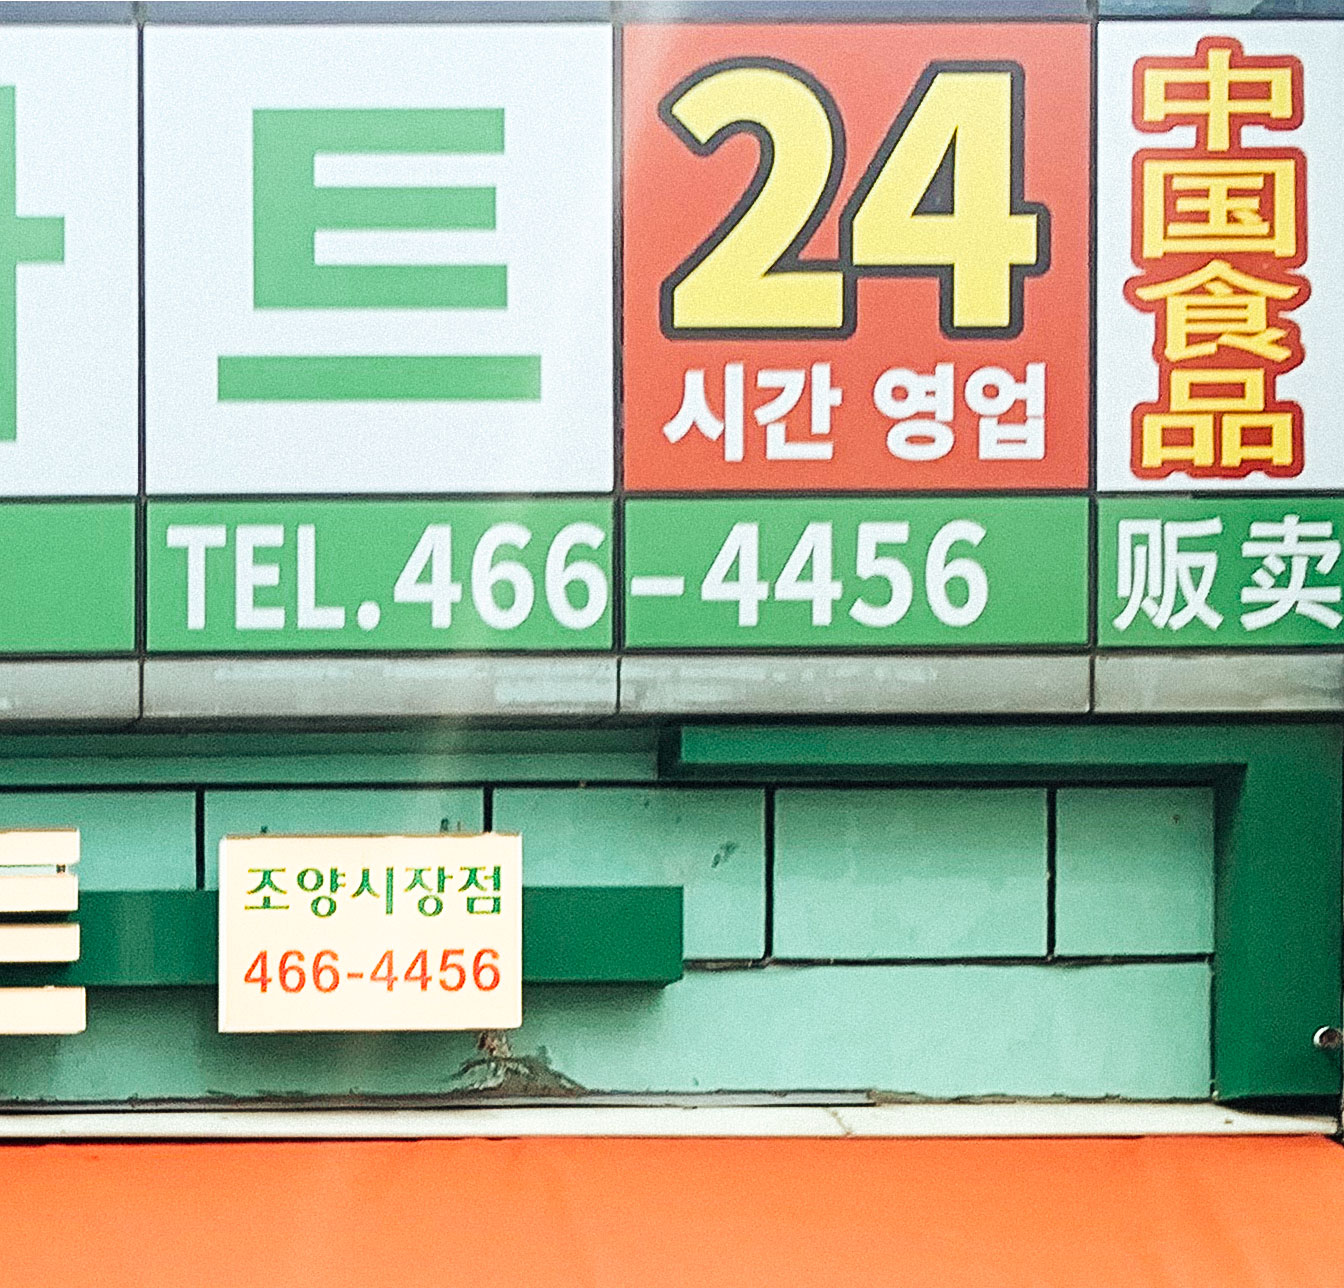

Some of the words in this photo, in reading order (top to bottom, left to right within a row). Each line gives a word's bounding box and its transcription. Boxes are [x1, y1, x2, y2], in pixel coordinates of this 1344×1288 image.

[659, 56, 1049, 339] 24
[1127, 38, 1309, 479] 中国食品
[663, 363, 841, 461] 시간
[874, 362, 1047, 461] 영업
[1112, 514, 1344, 633] 贩卖
[242, 864, 503, 919] 조양시장점
[242, 946, 501, 994] 466-4456
